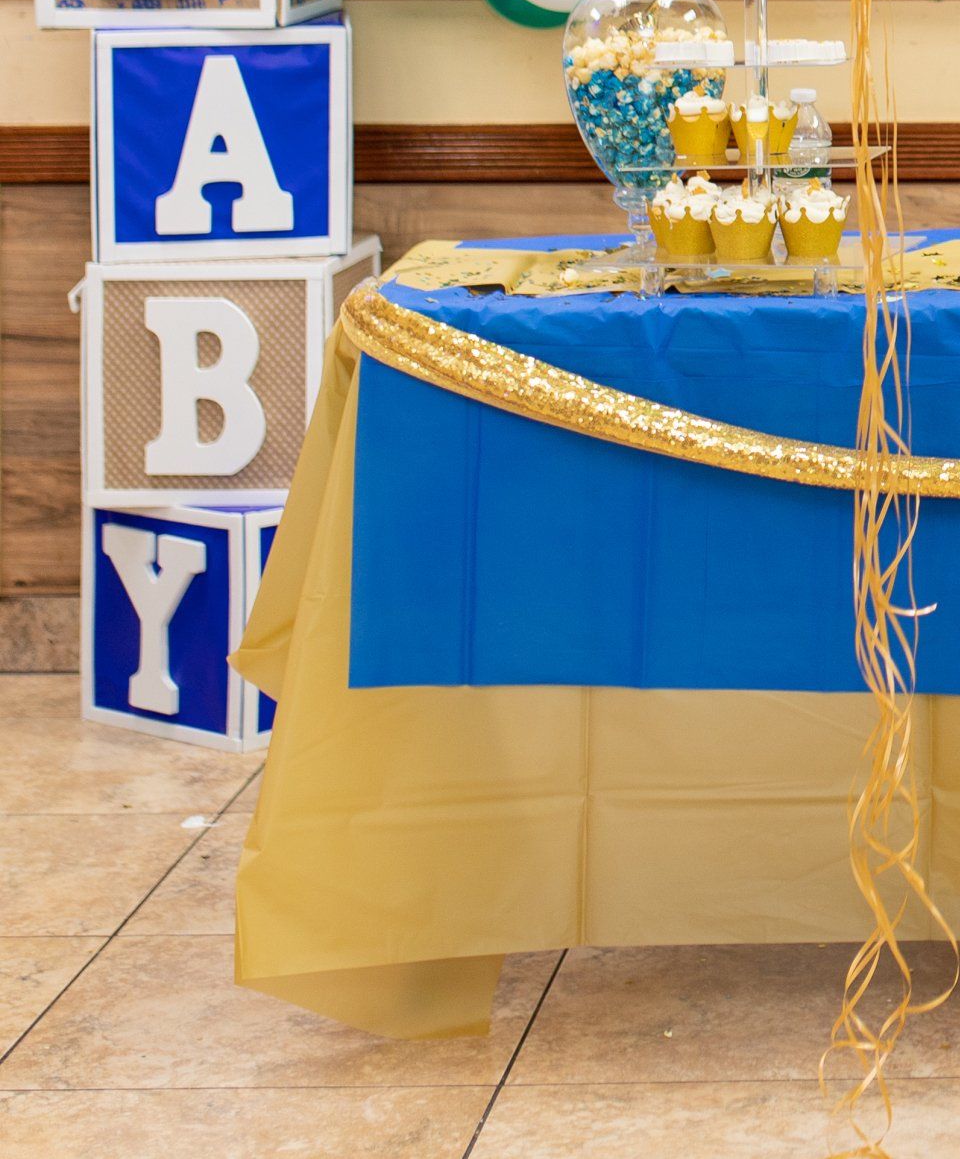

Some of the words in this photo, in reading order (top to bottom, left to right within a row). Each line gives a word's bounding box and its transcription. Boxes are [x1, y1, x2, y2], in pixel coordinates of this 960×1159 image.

[155, 55, 294, 235] A
[144, 296, 267, 476] B
[102, 523, 207, 716] Y
